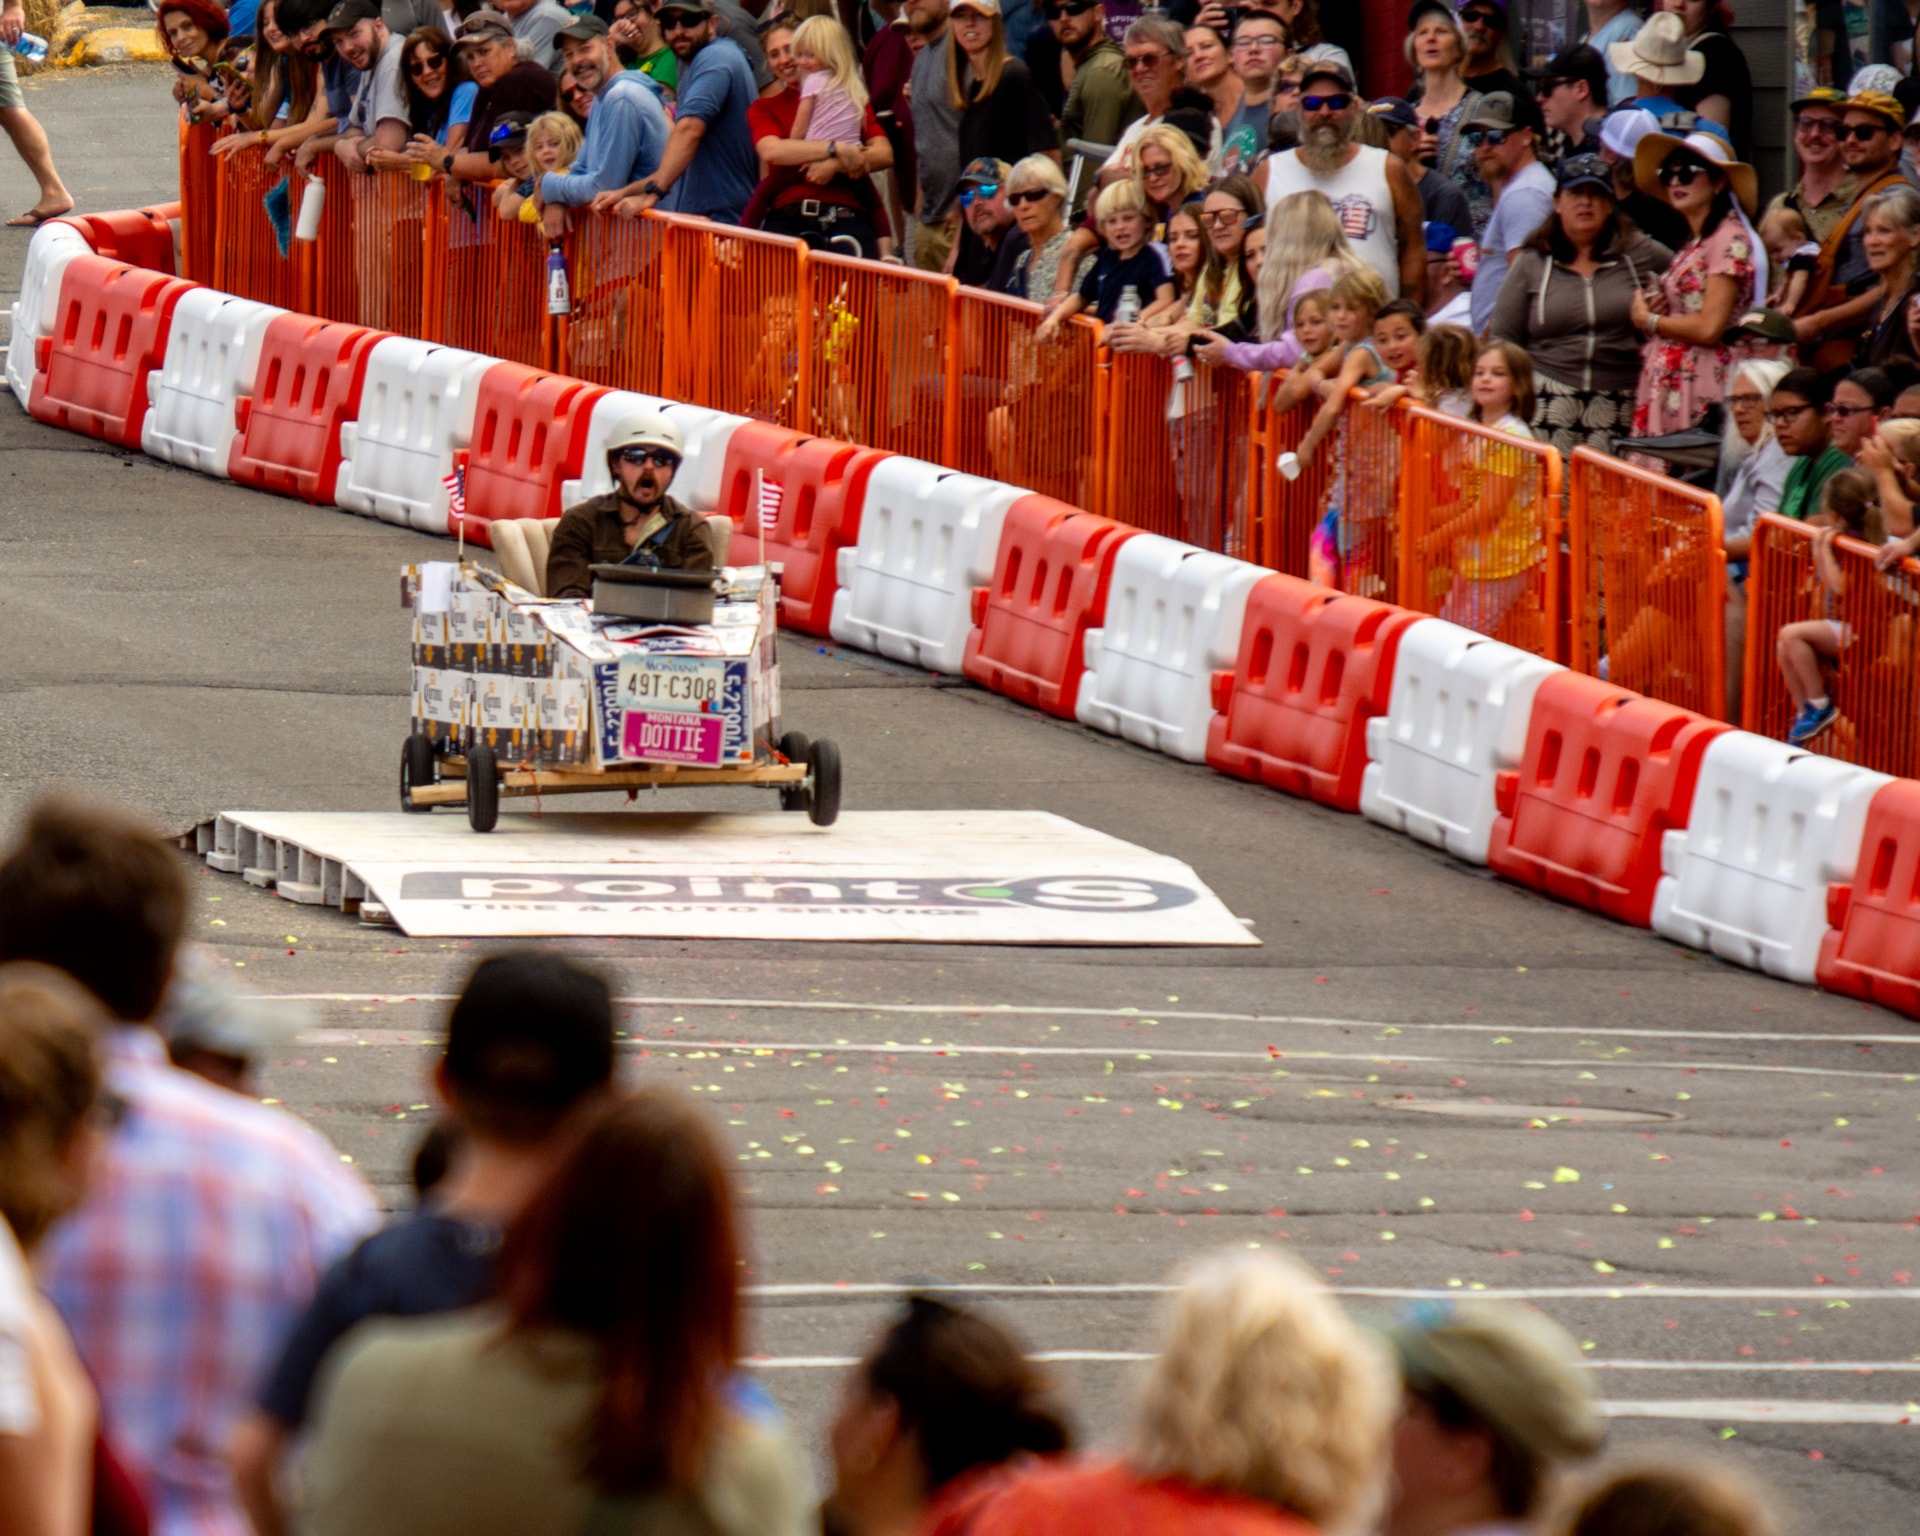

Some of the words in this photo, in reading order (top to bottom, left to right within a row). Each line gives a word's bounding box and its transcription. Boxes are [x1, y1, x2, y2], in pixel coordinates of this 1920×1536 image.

[639, 722, 706, 752] DOTTIE
[461, 876, 923, 900] point
[460, 903, 560, 912] TIRE
[629, 905, 759, 913] AUTO
[776, 906, 980, 916] SERVICE
